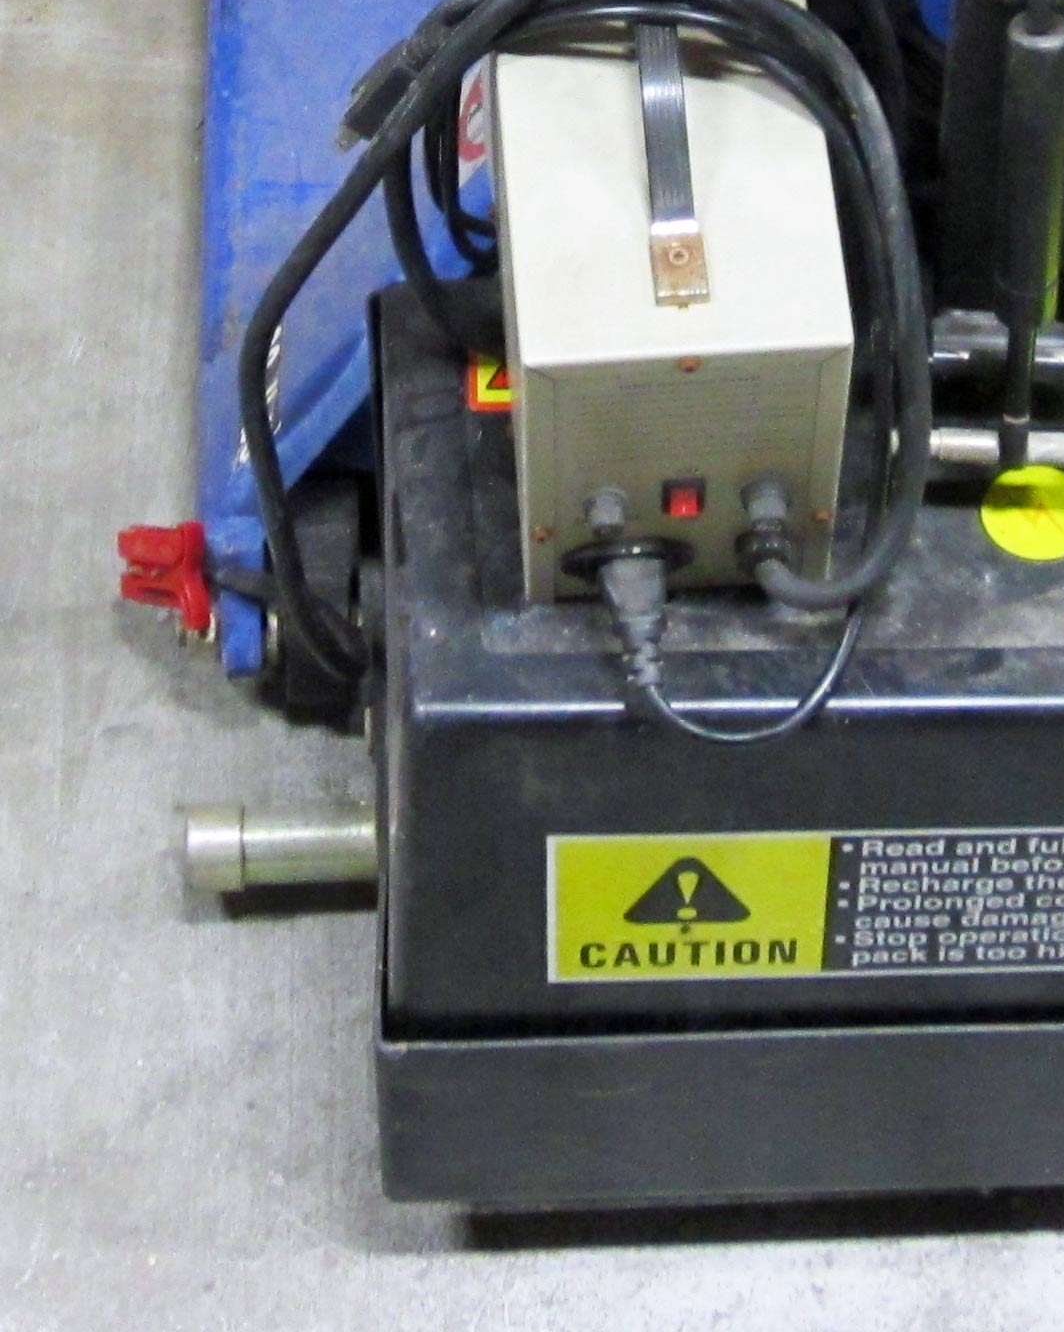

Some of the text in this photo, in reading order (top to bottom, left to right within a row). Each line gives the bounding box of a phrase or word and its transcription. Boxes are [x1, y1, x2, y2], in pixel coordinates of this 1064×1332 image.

[862, 839, 945, 857] Read
[956, 837, 1017, 856] and
[860, 857, 979, 875] manual
[859, 875, 1014, 895] Recharge
[857, 892, 1025, 914] Prolonged
[855, 915, 951, 929] cause
[853, 929, 928, 948] Stop
[580, 937, 798, 968] CAUTION
[852, 946, 928, 967] pack
[938, 947, 965, 962] is
[975, 945, 1027, 961] too
